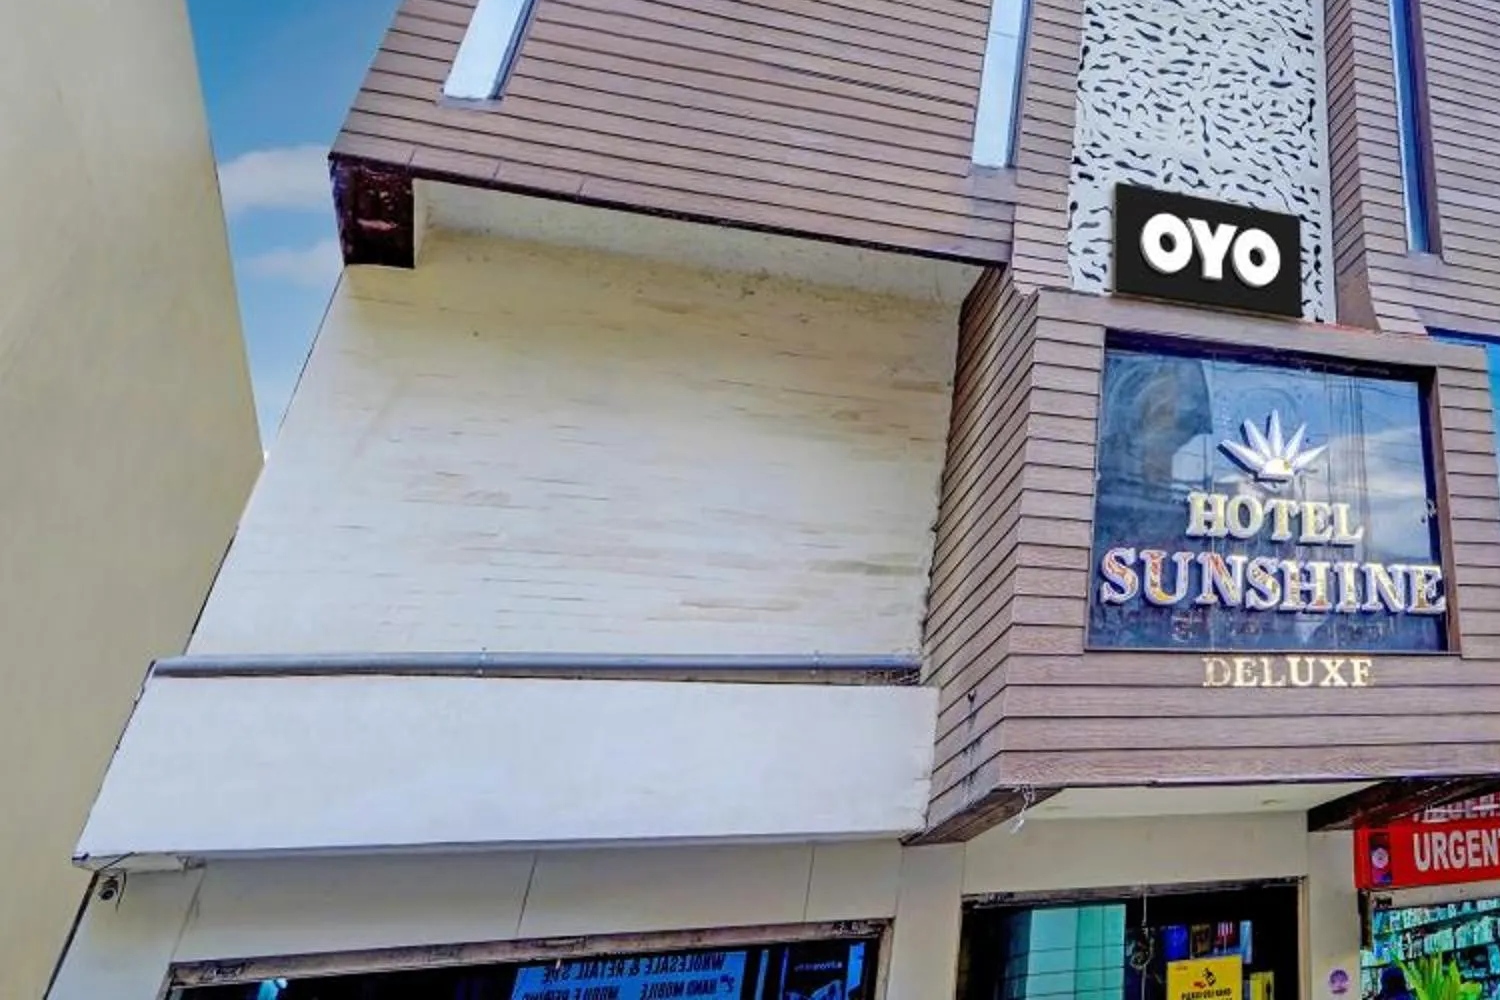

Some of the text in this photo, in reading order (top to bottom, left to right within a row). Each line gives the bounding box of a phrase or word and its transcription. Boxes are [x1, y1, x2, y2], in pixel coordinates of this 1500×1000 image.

[1140, 213, 1281, 288] OYO
[1185, 492, 1365, 544] HOTEL
[1101, 548, 1447, 614] SUNSHINE
